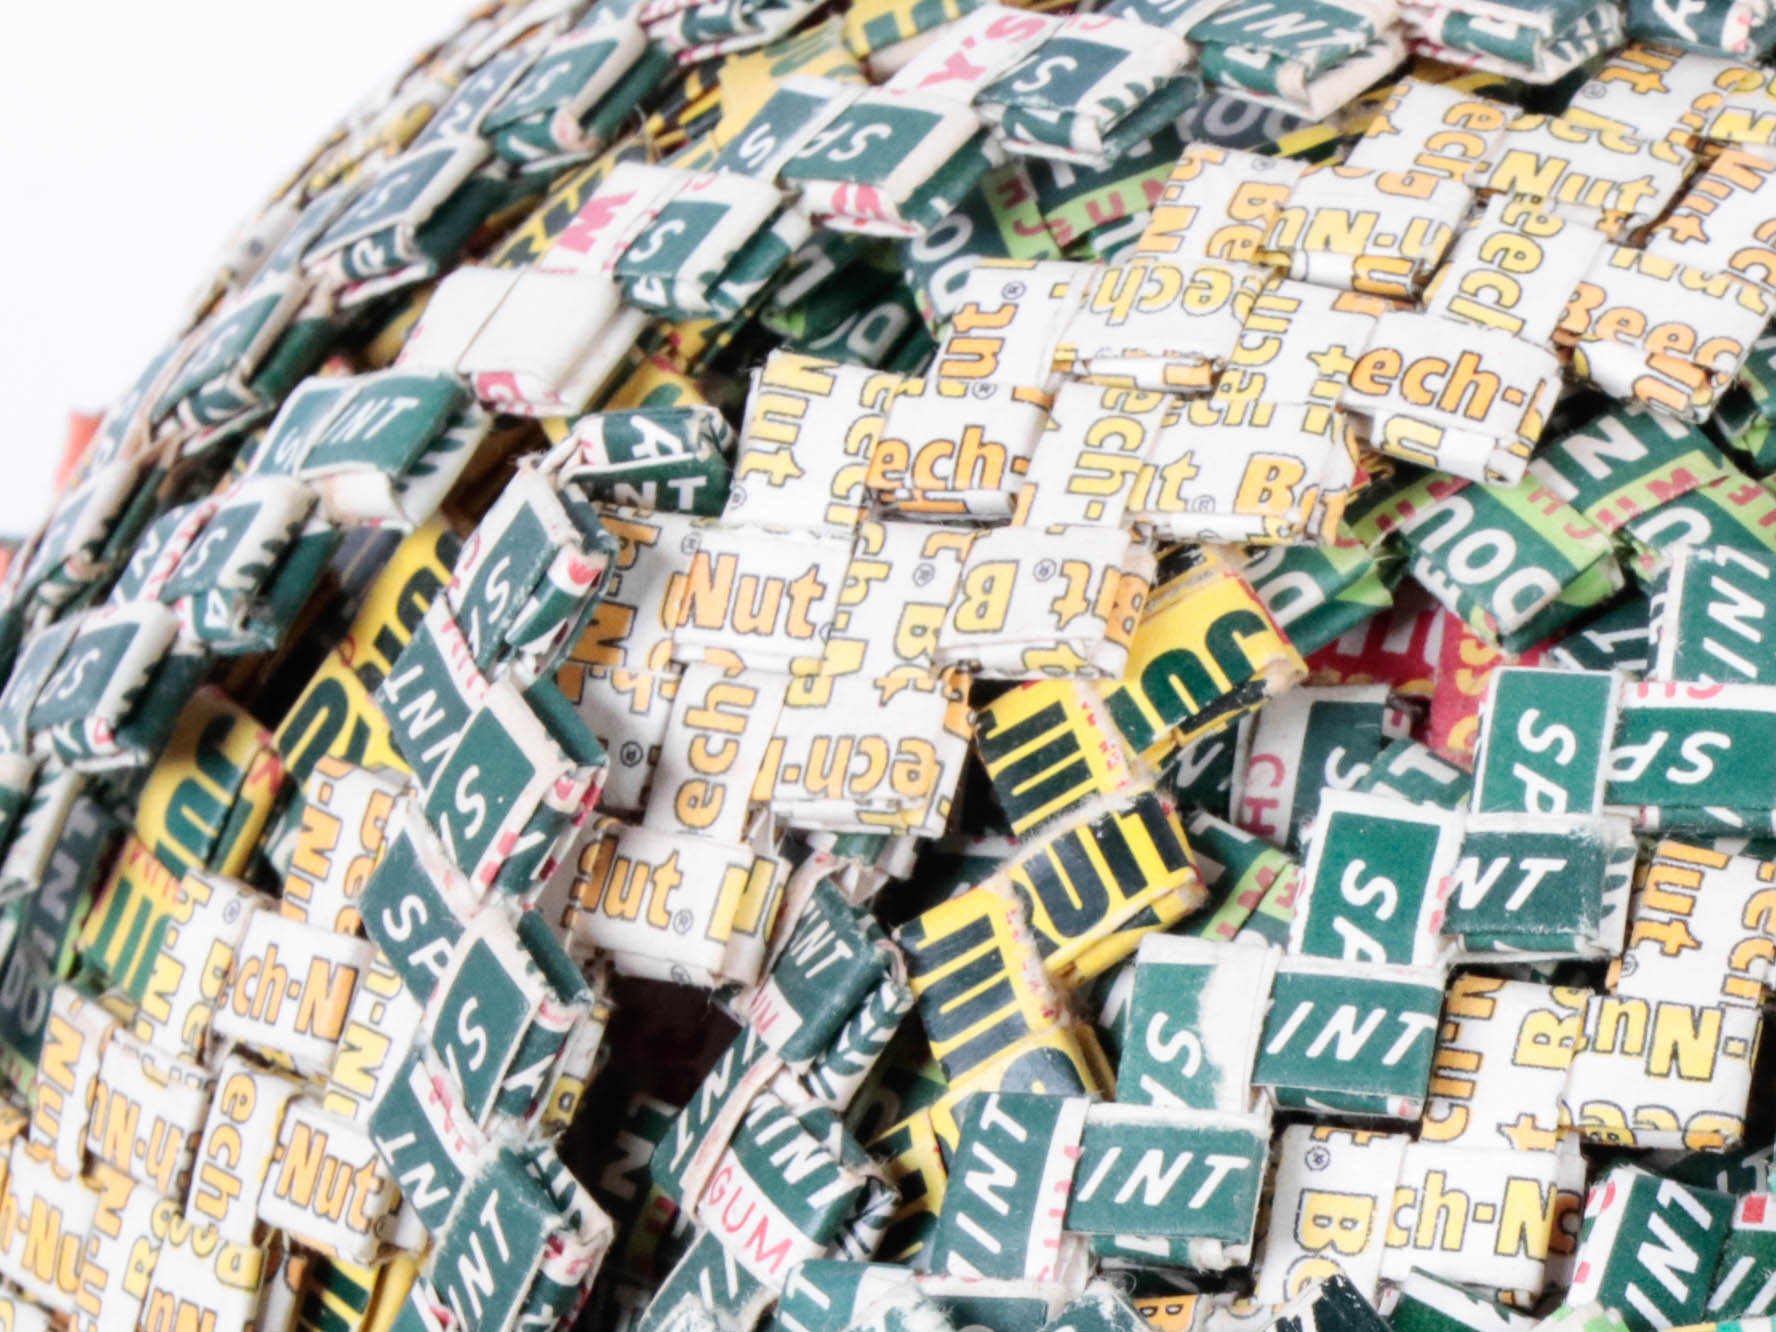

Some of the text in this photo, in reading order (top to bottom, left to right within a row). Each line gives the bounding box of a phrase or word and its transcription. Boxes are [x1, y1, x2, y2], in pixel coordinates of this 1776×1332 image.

[1491, 149, 1658, 216] Nut
[675, 549, 828, 640] Nut
[1399, 494, 1563, 633] DOU
[1267, 999, 1438, 1067] INT
[195, 1073, 257, 1221] ech
[277, 1119, 383, 1234] Nut
[1075, 1146, 1253, 1209] INT
[447, 1191, 513, 1320] INT
[708, 1166, 795, 1277] GUM
[1624, 1179, 1713, 1330] INT
